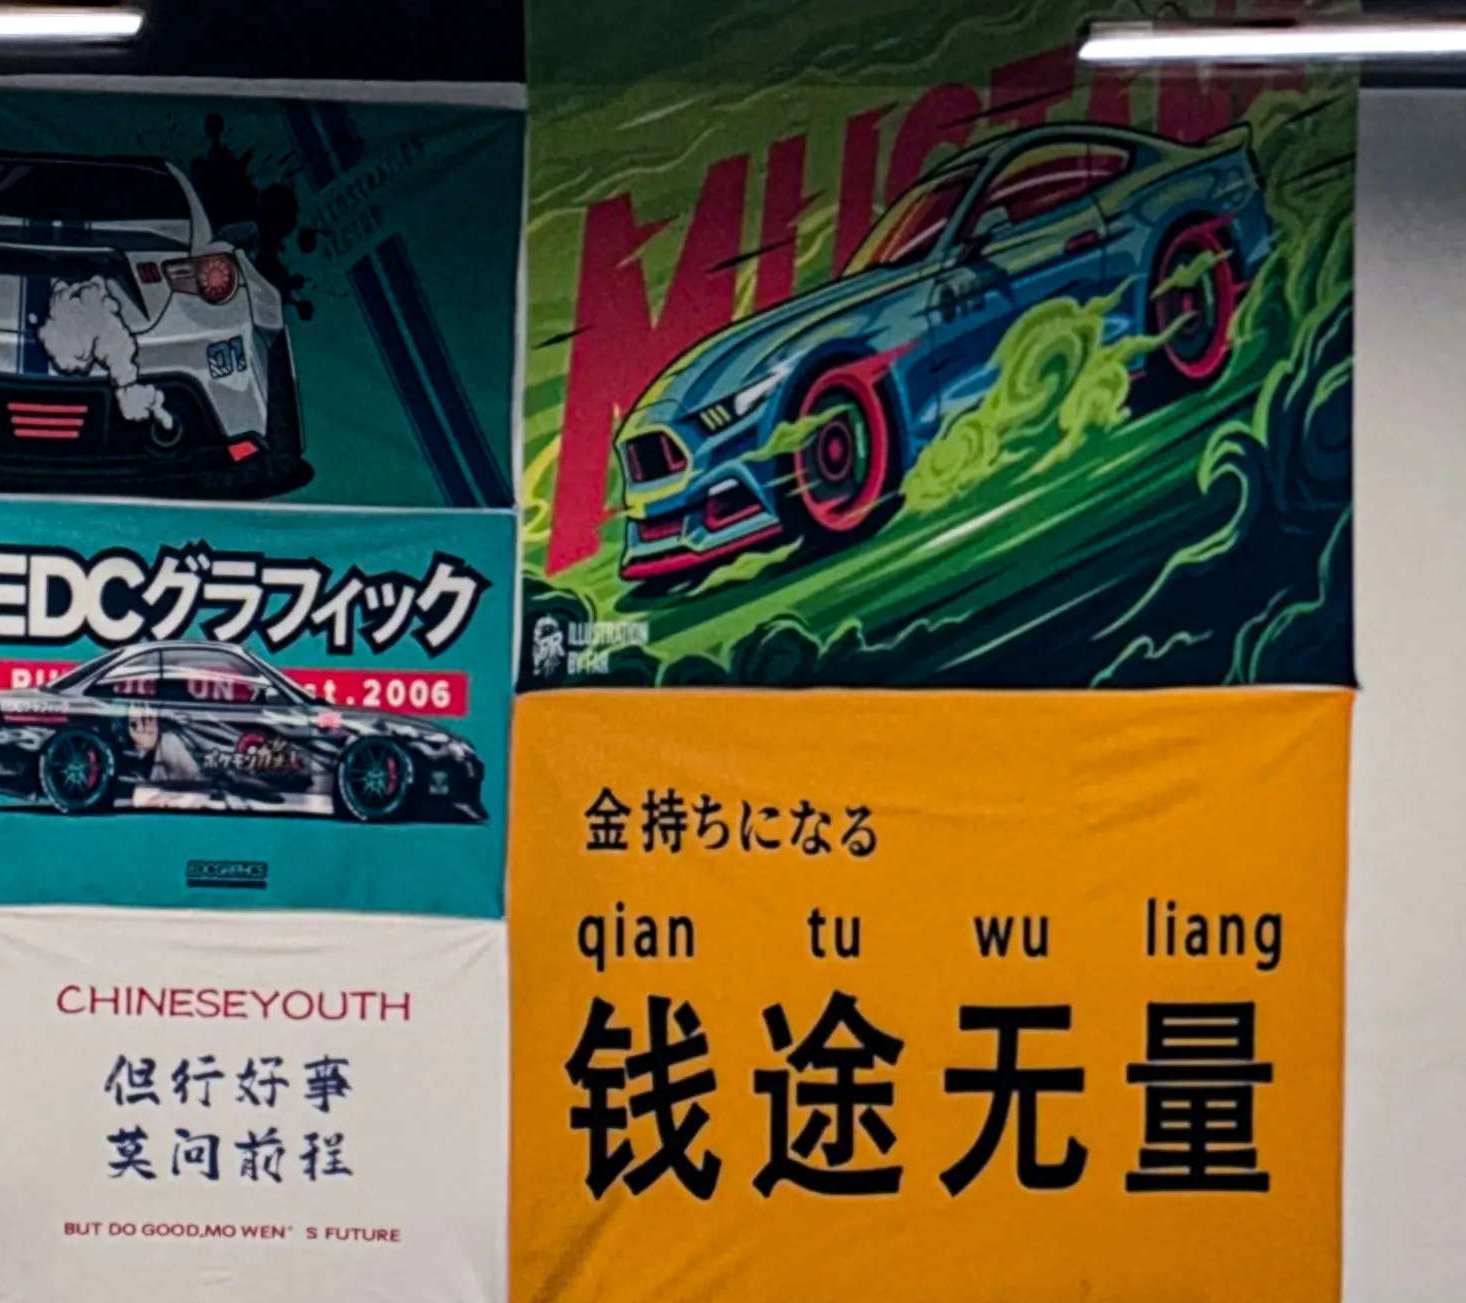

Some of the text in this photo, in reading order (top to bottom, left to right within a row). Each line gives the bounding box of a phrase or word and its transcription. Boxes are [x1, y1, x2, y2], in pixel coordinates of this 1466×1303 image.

[584, 786, 880, 860] 金持ちになる
[577, 897, 1285, 973] qian tu wu liang
[56, 985, 414, 1023] CHINESEYOUTH
[105, 1055, 354, 1114] 但行好事
[565, 989, 1277, 1203] 钱途无量
[107, 1125, 354, 1184] 莫问前程
[64, 1221, 101, 1238] BUT
[108, 1222, 136, 1238] DO
[306, 1226, 318, 1240] S
[325, 1226, 401, 1243] FUTURE
